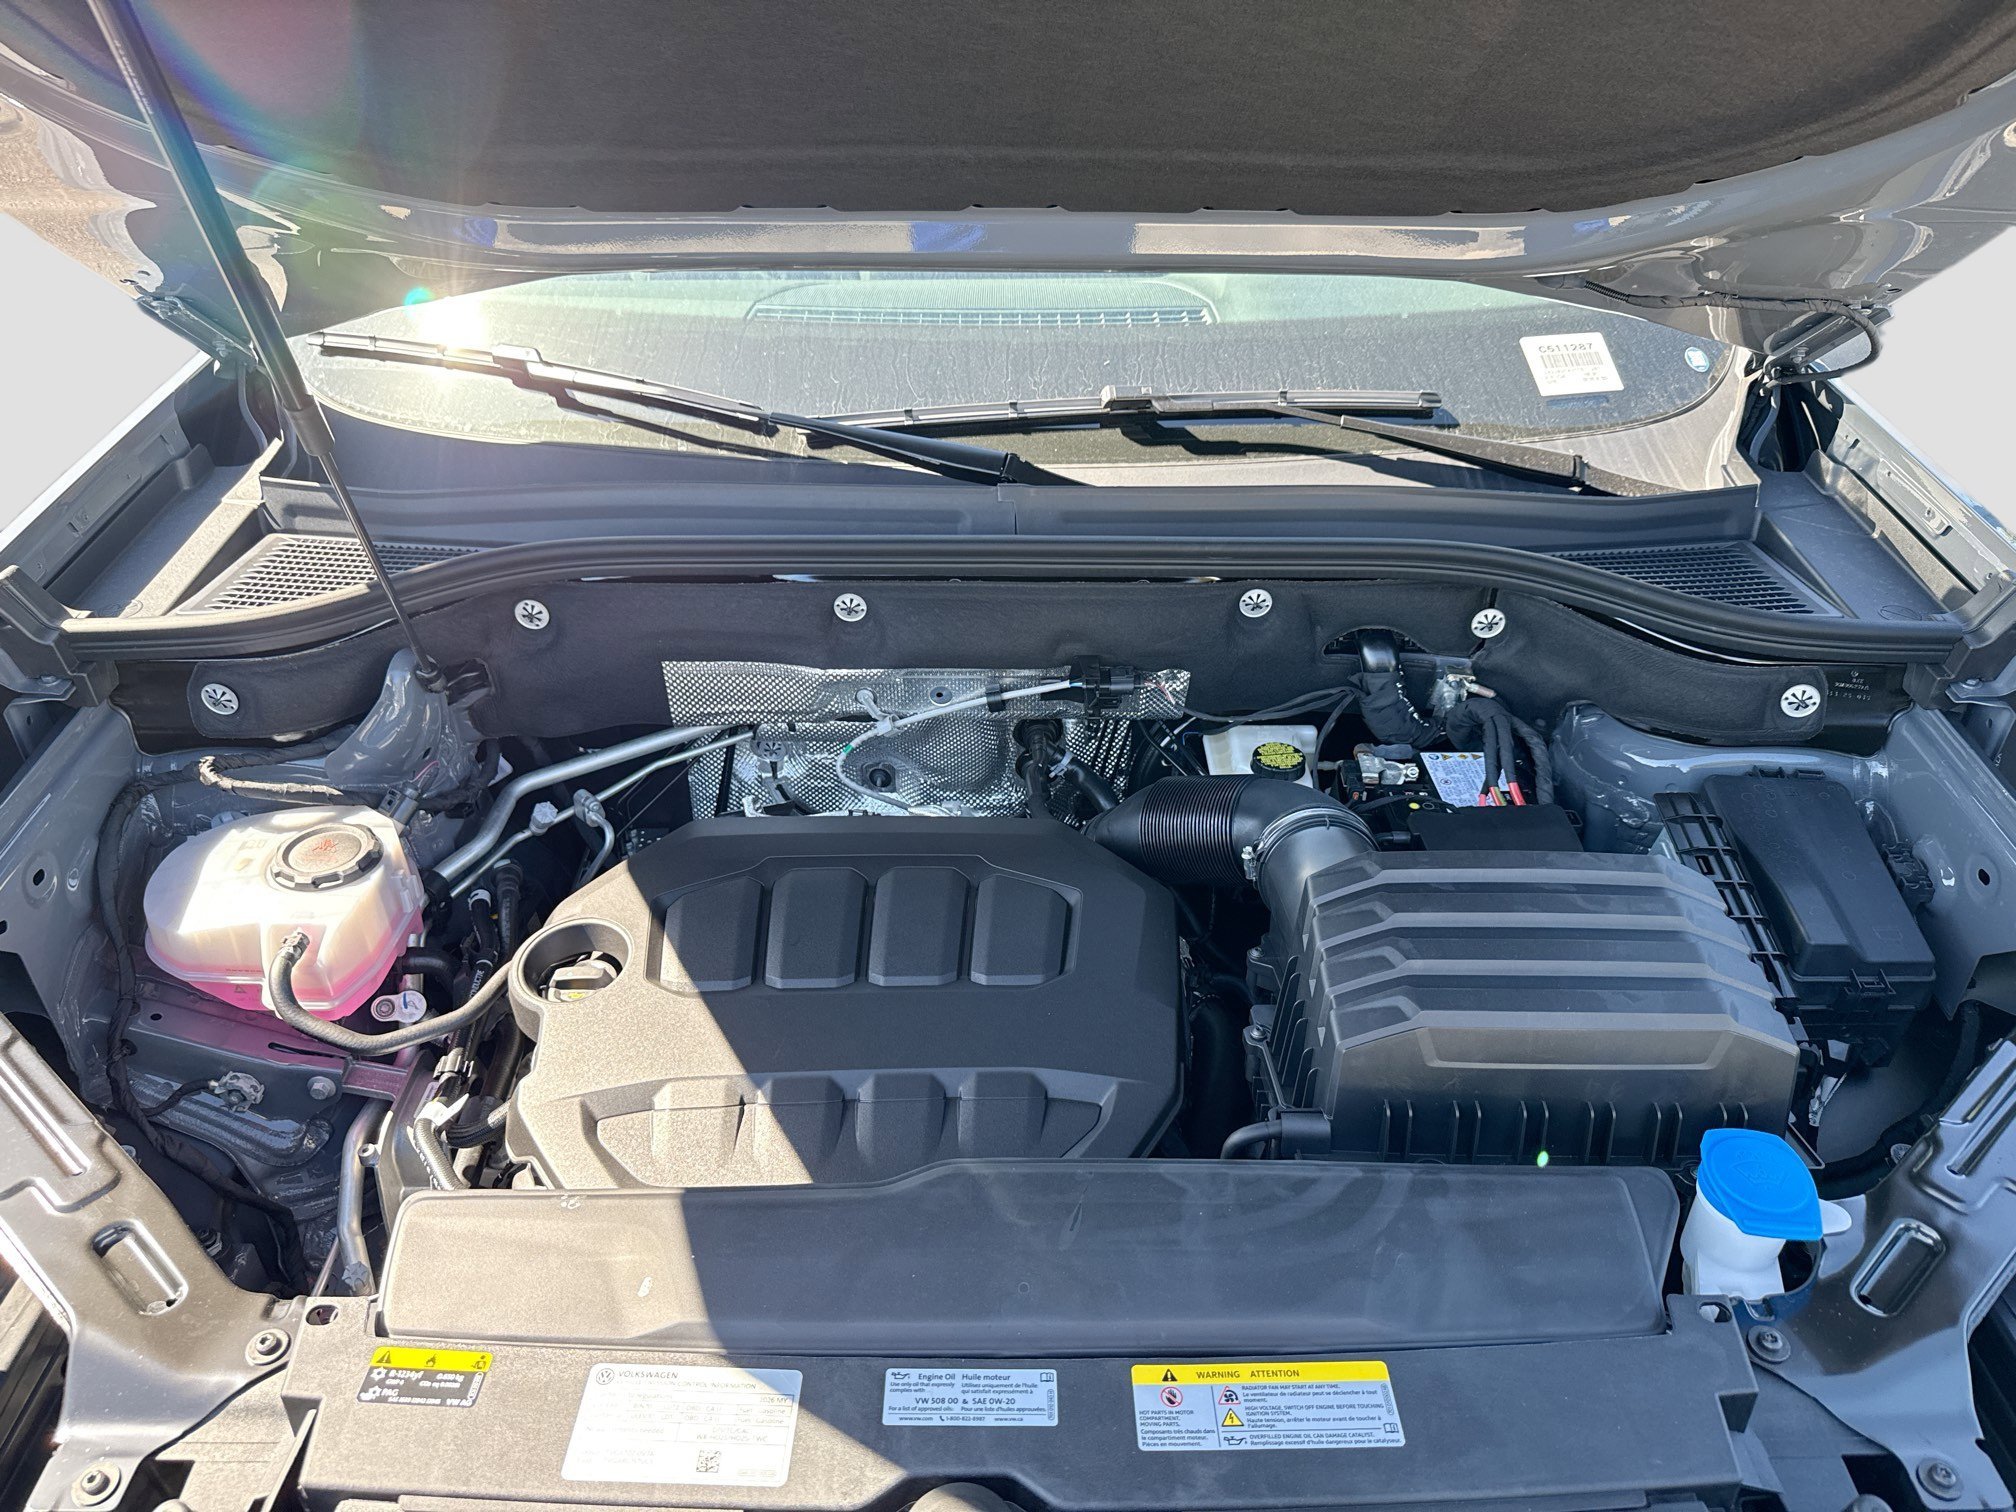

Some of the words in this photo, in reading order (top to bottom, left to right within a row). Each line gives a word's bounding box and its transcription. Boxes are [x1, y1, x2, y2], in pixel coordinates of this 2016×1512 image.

[1538, 343, 1592, 353] C511287
[918, 1374, 943, 1382] Engine
[1196, 1371, 1240, 1379] WARNING
[1250, 1370, 1300, 1378] ATTENTION
